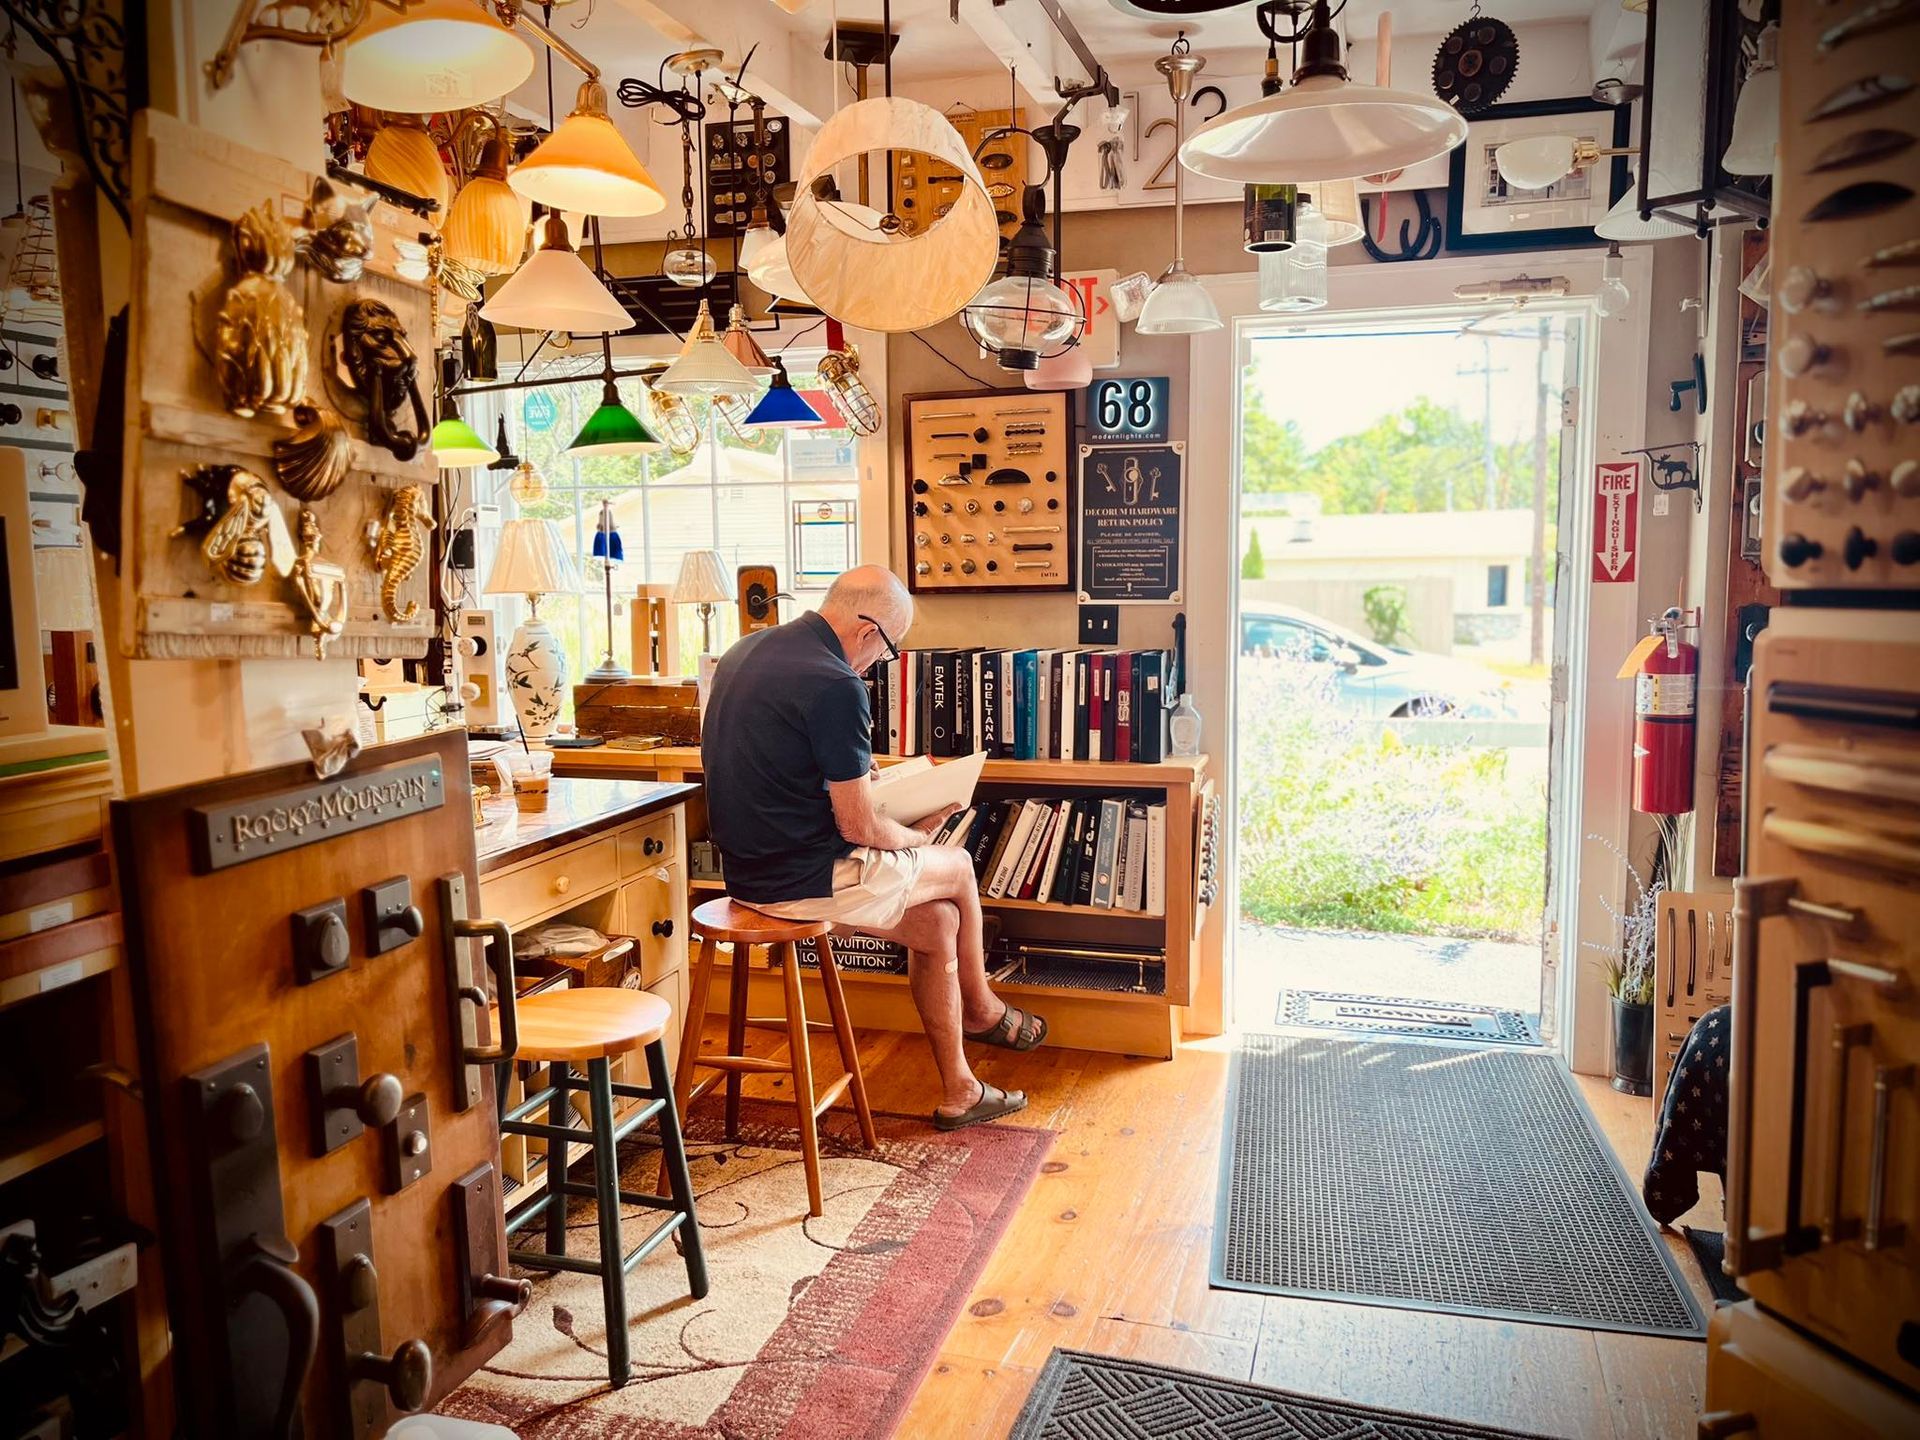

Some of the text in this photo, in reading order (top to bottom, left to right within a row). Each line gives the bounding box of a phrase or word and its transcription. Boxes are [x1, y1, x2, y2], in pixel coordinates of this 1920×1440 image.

[1098, 381, 1151, 429] 68
[1091, 432, 1161, 440] modernlights.com
[1602, 474, 1631, 490] FIRE
[1085, 506, 1178, 516] DECORUM HARDWARE
[1097, 518, 1164, 527] RETURN POLICY
[1610, 493, 1620, 571] EXTINGUISHER
[934, 666, 944, 709] EMTEK
[985, 683, 994, 740] DELTANA
[233, 776, 426, 844] ROCKY MOUNTAIN
[975, 834, 989, 862] Schaub
[836, 938, 885, 951] VUITTON
[836, 954, 886, 967] VUITTON
